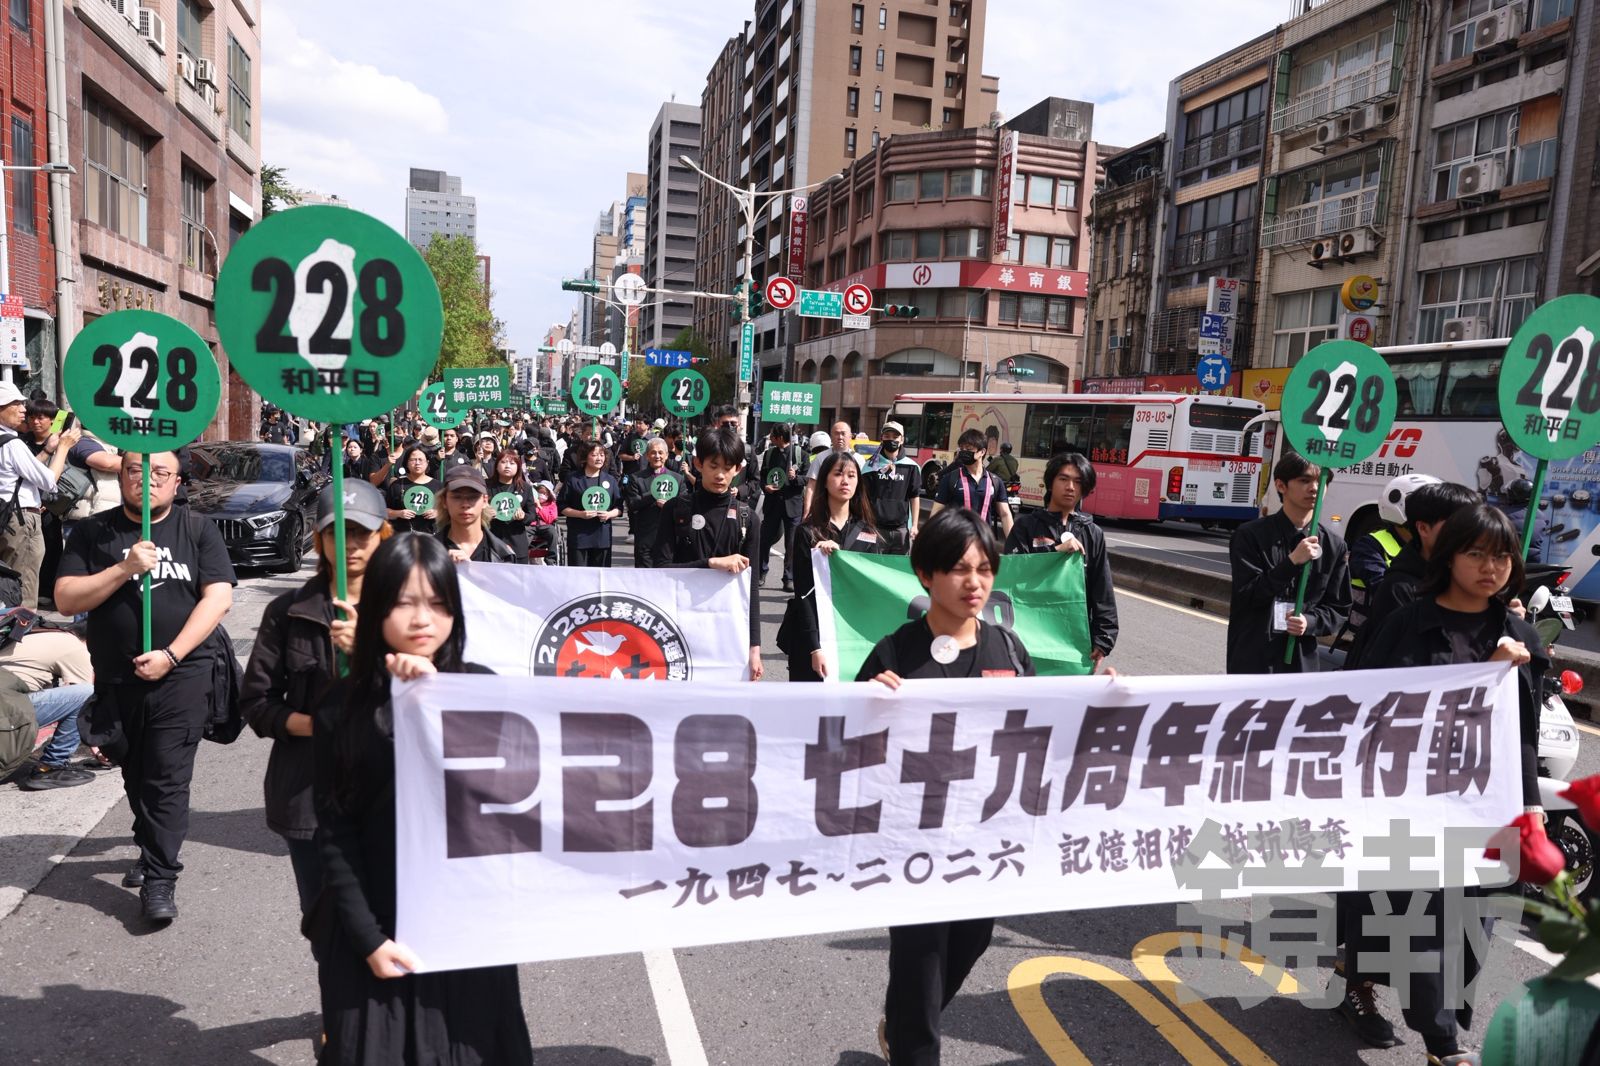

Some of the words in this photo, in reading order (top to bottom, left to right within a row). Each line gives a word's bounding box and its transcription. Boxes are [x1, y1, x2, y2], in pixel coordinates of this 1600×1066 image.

[793, 213, 804, 257] 華南銀行
[999, 268, 1088, 292] 華南銀
[1216, 279, 1238, 289] 東方
[252, 257, 406, 358] 228
[1202, 316, 1212, 331] P
[92, 344, 198, 413] 228
[281, 367, 380, 396] 和平日
[1515, 333, 1600, 414] 228
[453, 390, 502, 402] 轉向光明
[579, 377, 613, 401] 228
[671, 378, 704, 401] 228
[770, 390, 813, 403] 傷痕歷史
[426, 391, 461, 413] 22
[769, 403, 813, 417] 持續修復
[1301, 369, 1384, 433] 228
[108, 416, 178, 437] 和平日
[1136, 411, 1167, 423] 378-U3
[1524, 413, 1581, 440] 和平日
[1306, 437, 1356, 459] 和平日
[1228, 461, 1257, 475] 378-U3
[656, 481, 673, 492] 228
[410, 492, 429, 505] 228
[496, 498, 515, 511] 228
[588, 493, 605, 505] 228
[442, 709, 759, 859] 228
[1057, 824, 1201, 876] 記憶相依
